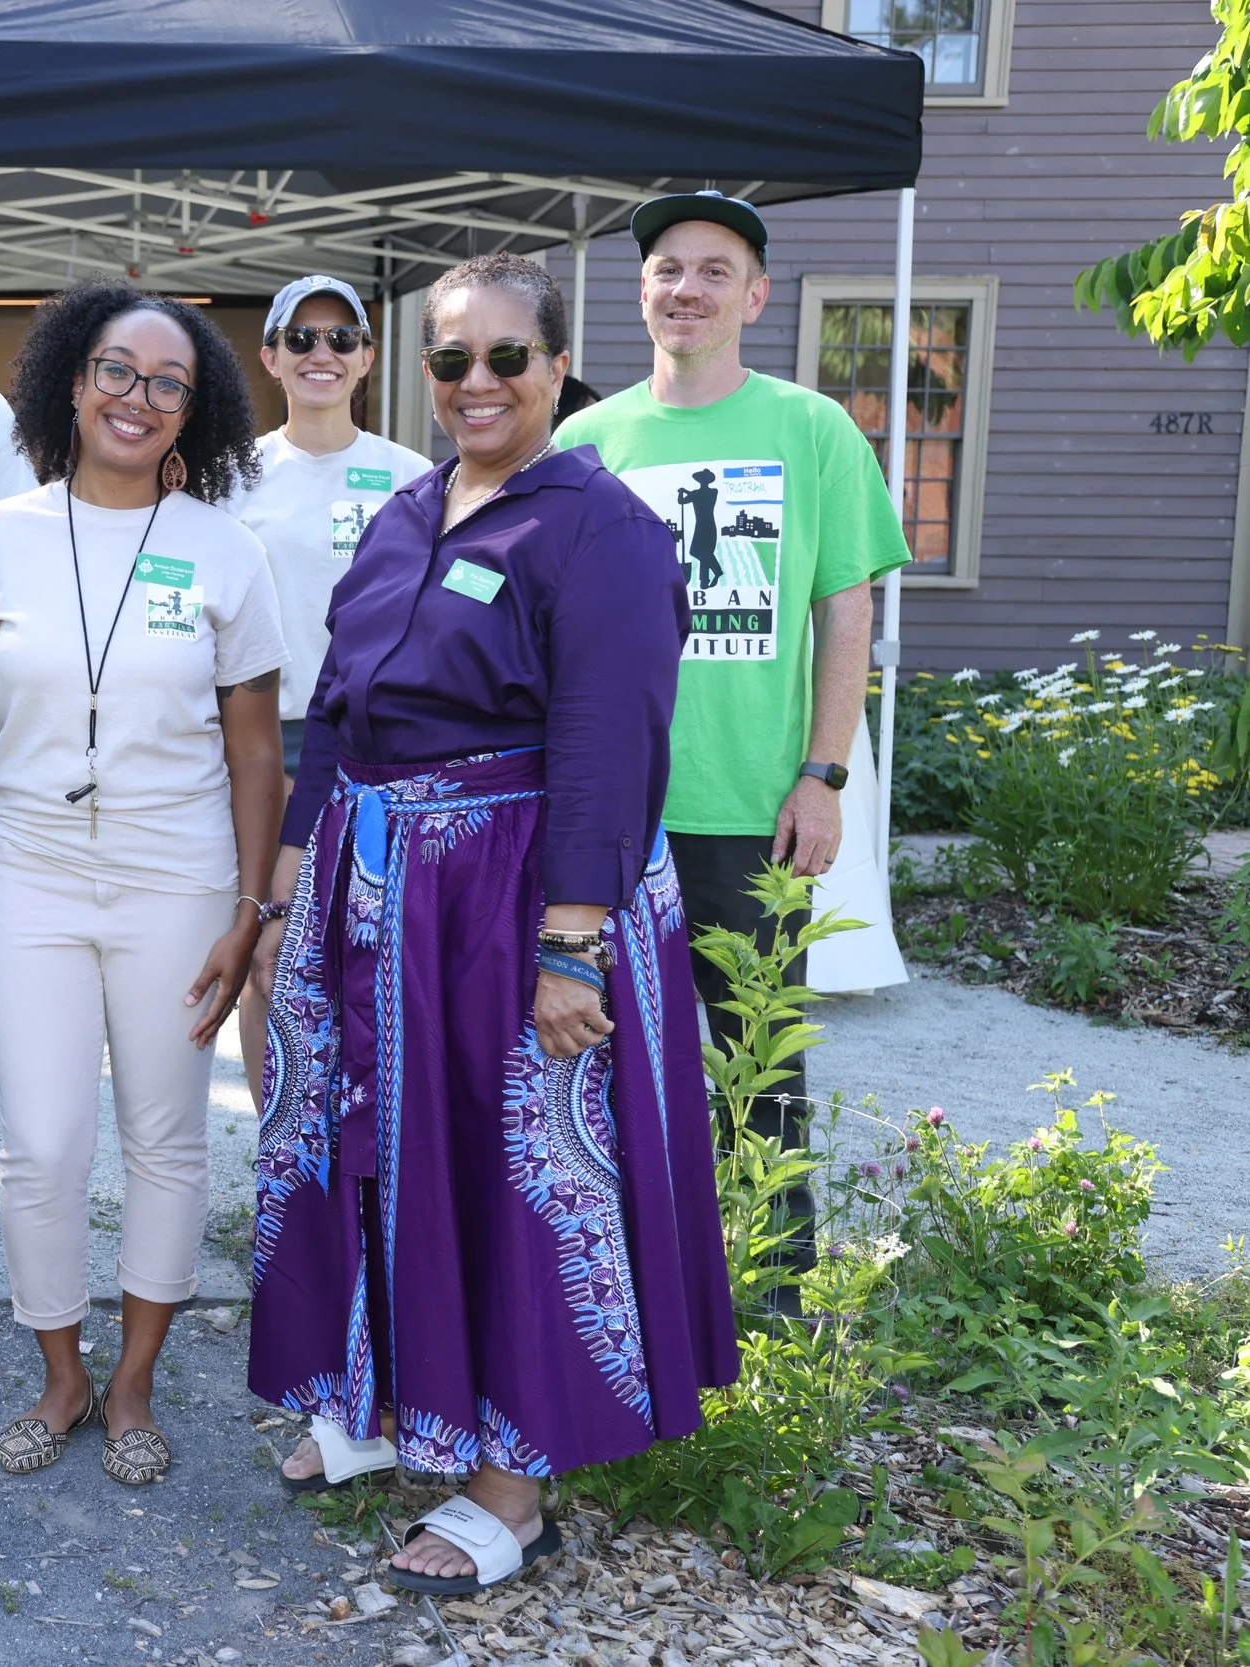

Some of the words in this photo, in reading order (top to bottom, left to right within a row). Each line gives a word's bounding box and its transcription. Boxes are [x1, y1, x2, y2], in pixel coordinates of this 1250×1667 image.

[1149, 412, 1214, 434] 487R
[743, 466, 761, 474] Hello
[693, 589, 772, 607] BAN
[692, 614, 759, 631] MING
[693, 639, 771, 656] ITUTE
